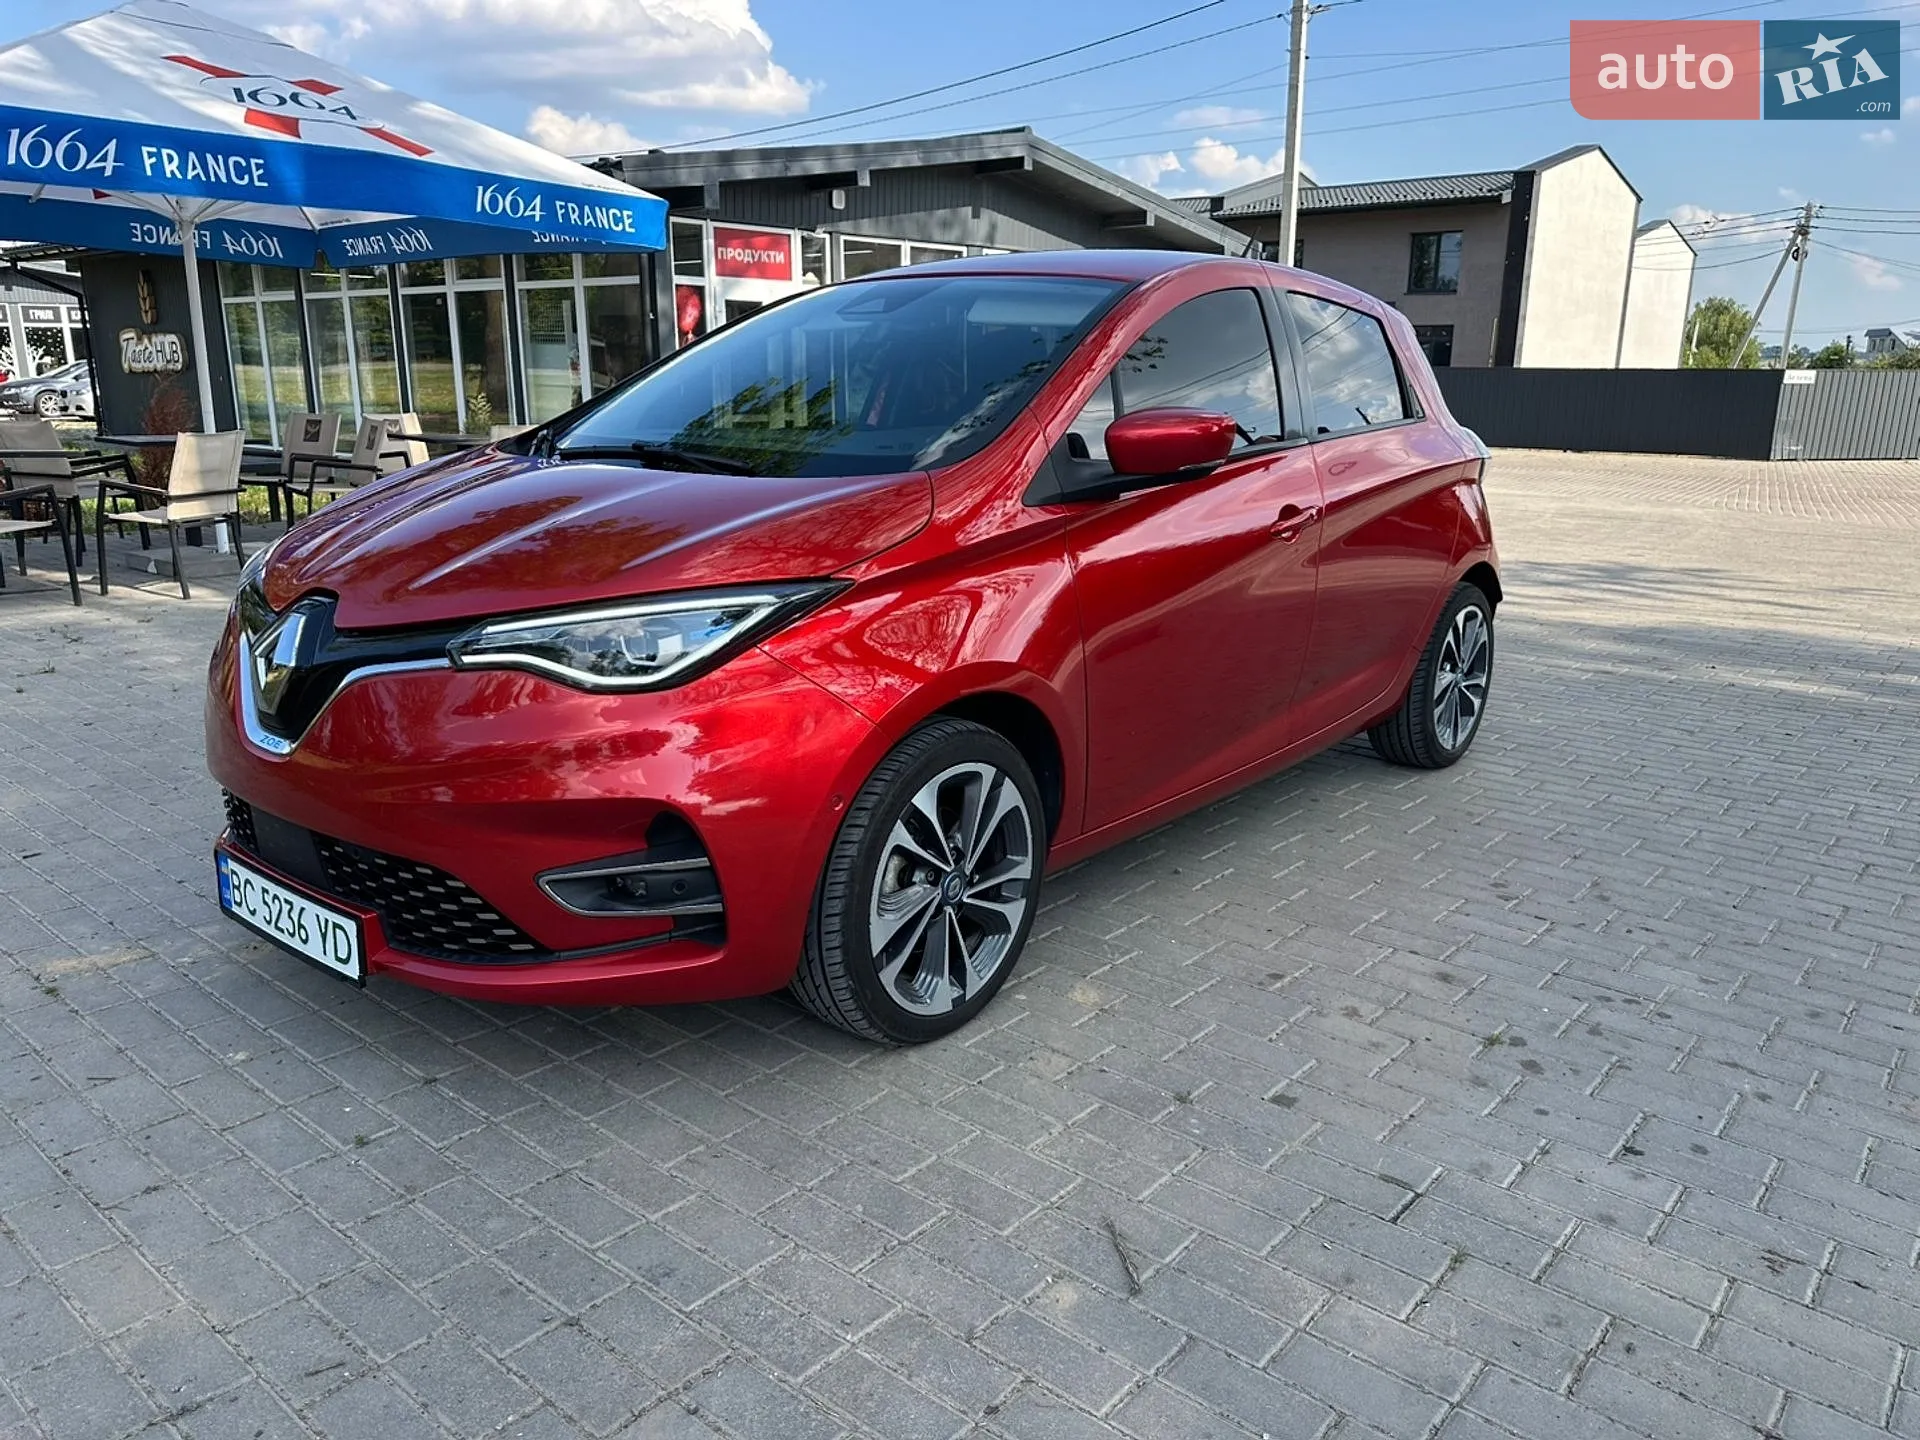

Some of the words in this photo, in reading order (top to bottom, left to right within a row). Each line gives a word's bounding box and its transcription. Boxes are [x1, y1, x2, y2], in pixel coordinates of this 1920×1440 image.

[232, 86, 358, 121] 1664
[7, 124, 125, 177] 1664
[141, 145, 269, 187] FRANCE
[475, 183, 547, 222] 1664
[555, 200, 636, 233] FRANCE
[717, 246, 785, 264] ПРОДУКТИ
[230, 868, 257, 917] BC
[261, 886, 310, 945] 5236
[315, 912, 352, 966] YD
